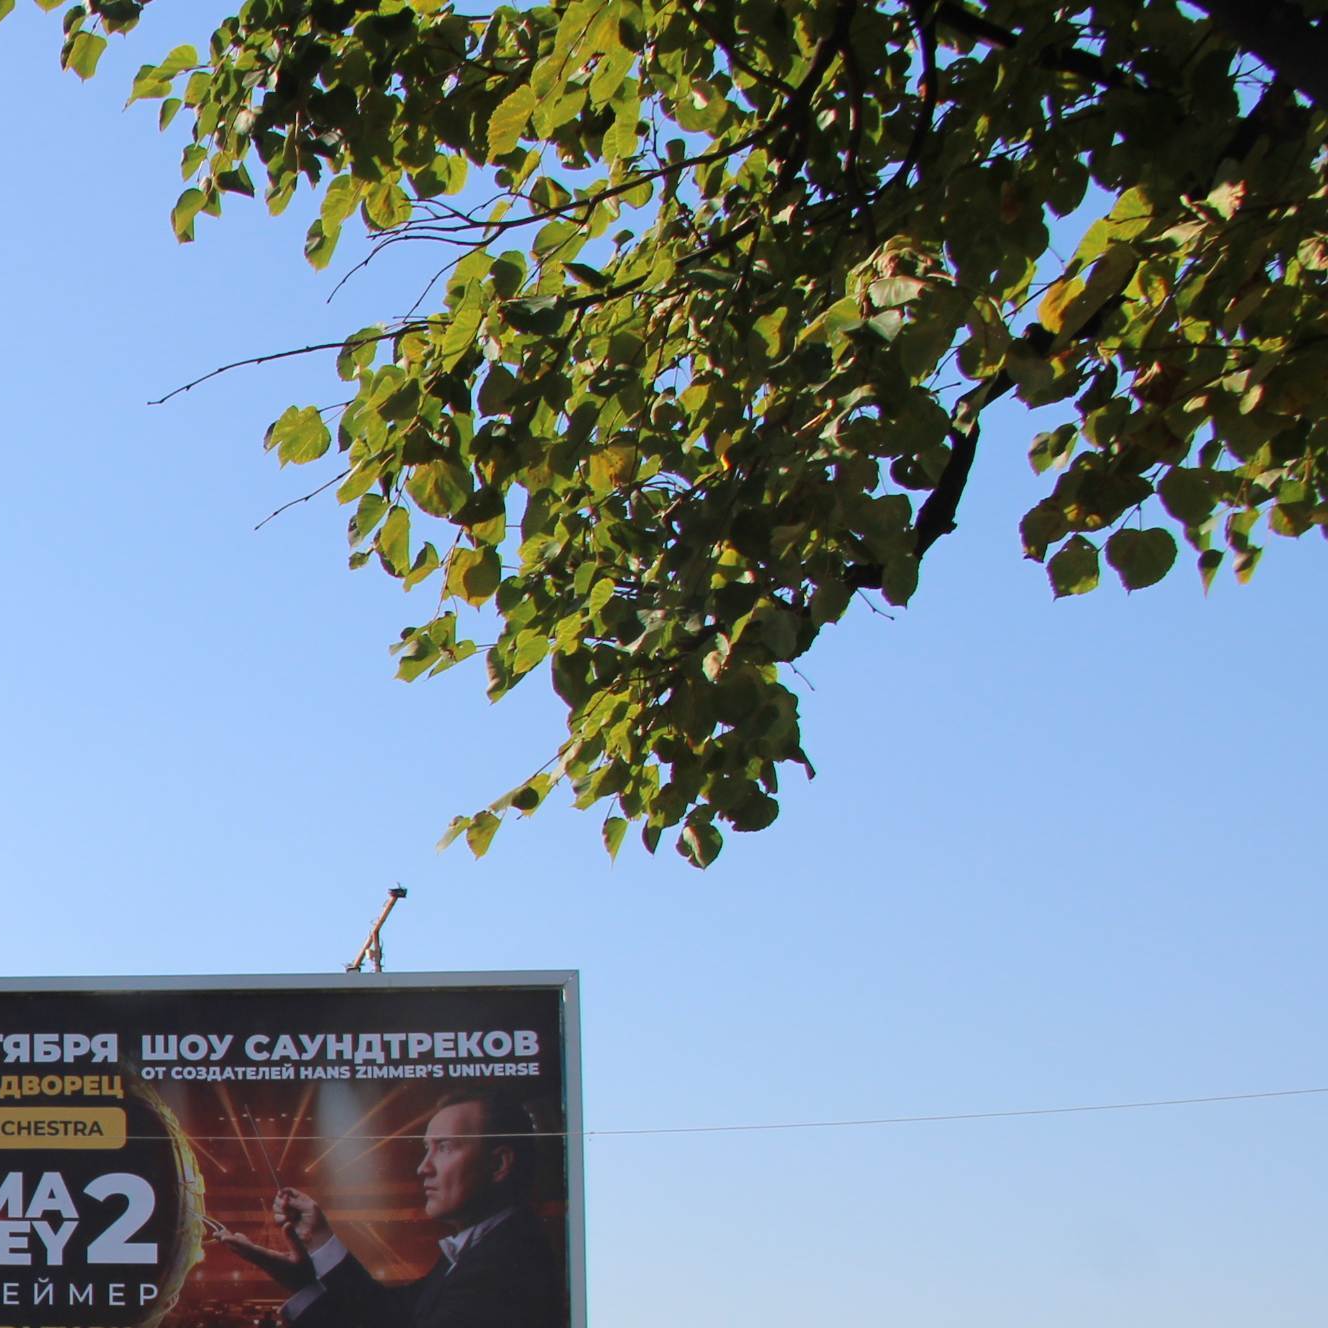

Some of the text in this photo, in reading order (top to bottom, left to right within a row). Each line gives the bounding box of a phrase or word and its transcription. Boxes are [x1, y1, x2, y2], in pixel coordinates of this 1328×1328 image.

[141, 1030, 540, 1064] ШОУ САУНДТРЕКОВ
[141, 1066, 166, 1080] ОТ
[171, 1063, 295, 1082] СОЗДАТЕЛЕЙ
[300, 1065, 351, 1080] HANS
[449, 1062, 540, 1077] UNIVERSE
[83, 1172, 158, 1264] 2
